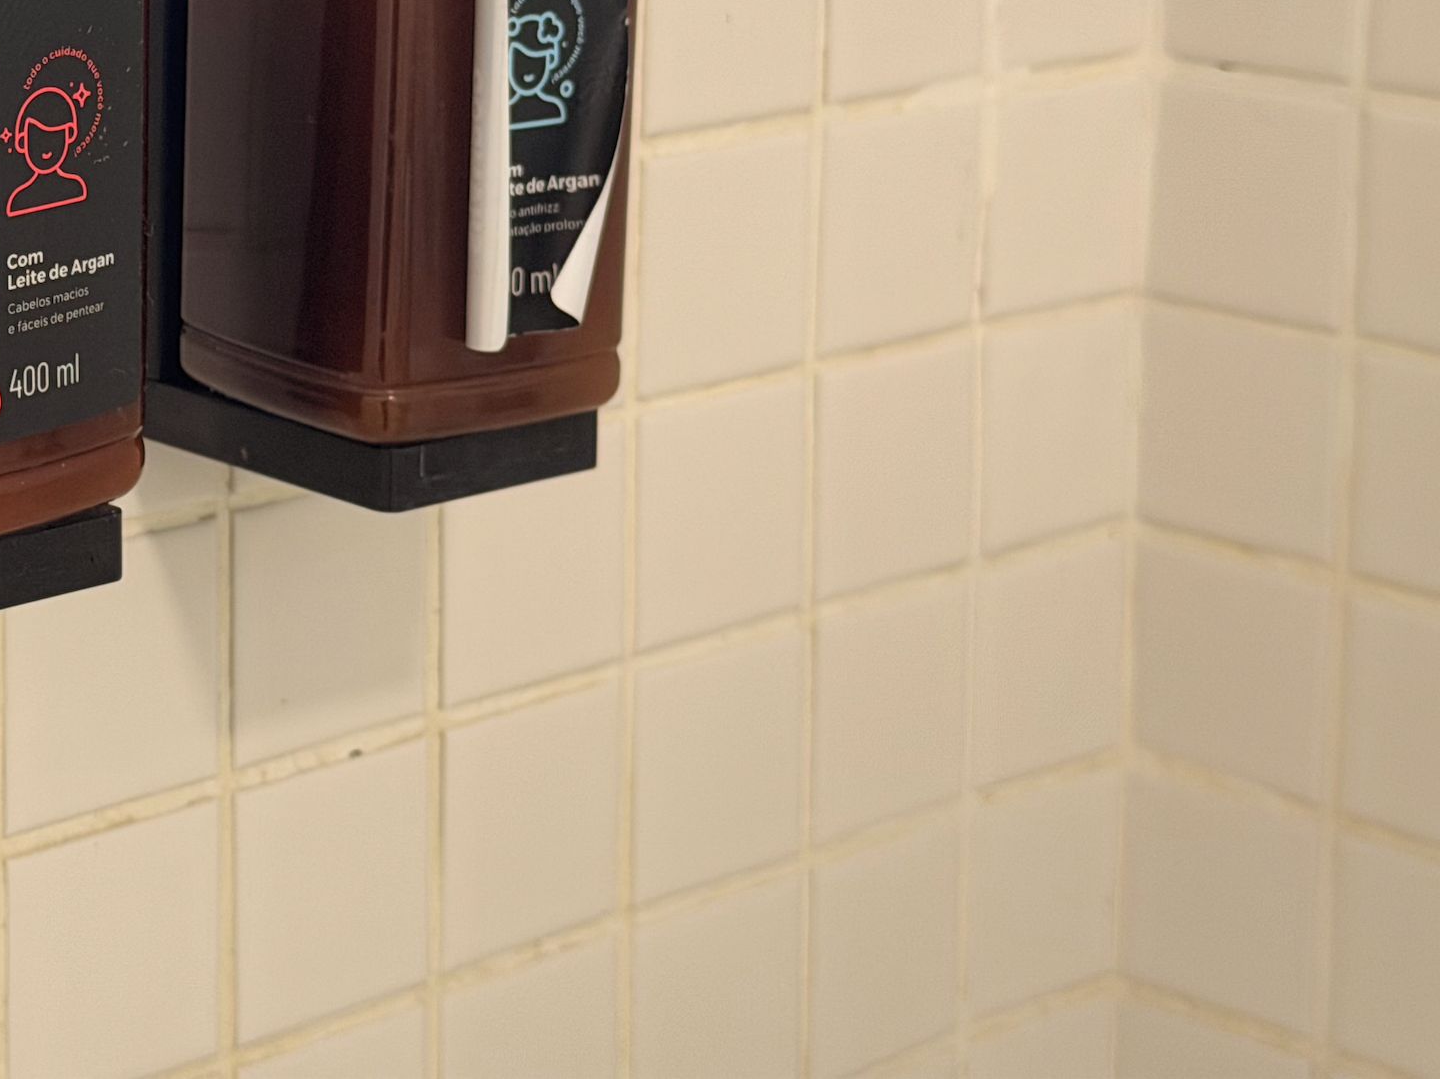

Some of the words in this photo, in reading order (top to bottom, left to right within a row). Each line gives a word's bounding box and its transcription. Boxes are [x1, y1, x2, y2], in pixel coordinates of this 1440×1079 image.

[23, 63, 42, 91] todo
[42, 56, 49, 65] o
[49, 46, 88, 61] cuidado
[86, 59, 101, 80] que
[526, 177, 545, 194] de
[547, 173, 601, 194] Argan
[6, 250, 44, 270] Com
[7, 269, 47, 291] Leite
[49, 263, 69, 281] de
[71, 252, 115, 275] Argan
[7, 295, 51, 315] Cabelos
[53, 286, 90, 305] macios
[8, 323, 16, 335] e
[17, 315, 49, 333] fáceis
[50, 312, 65, 325] de
[66, 301, 105, 323] pentear
[9, 361, 50, 399] 400
[56, 352, 80, 389] ml
